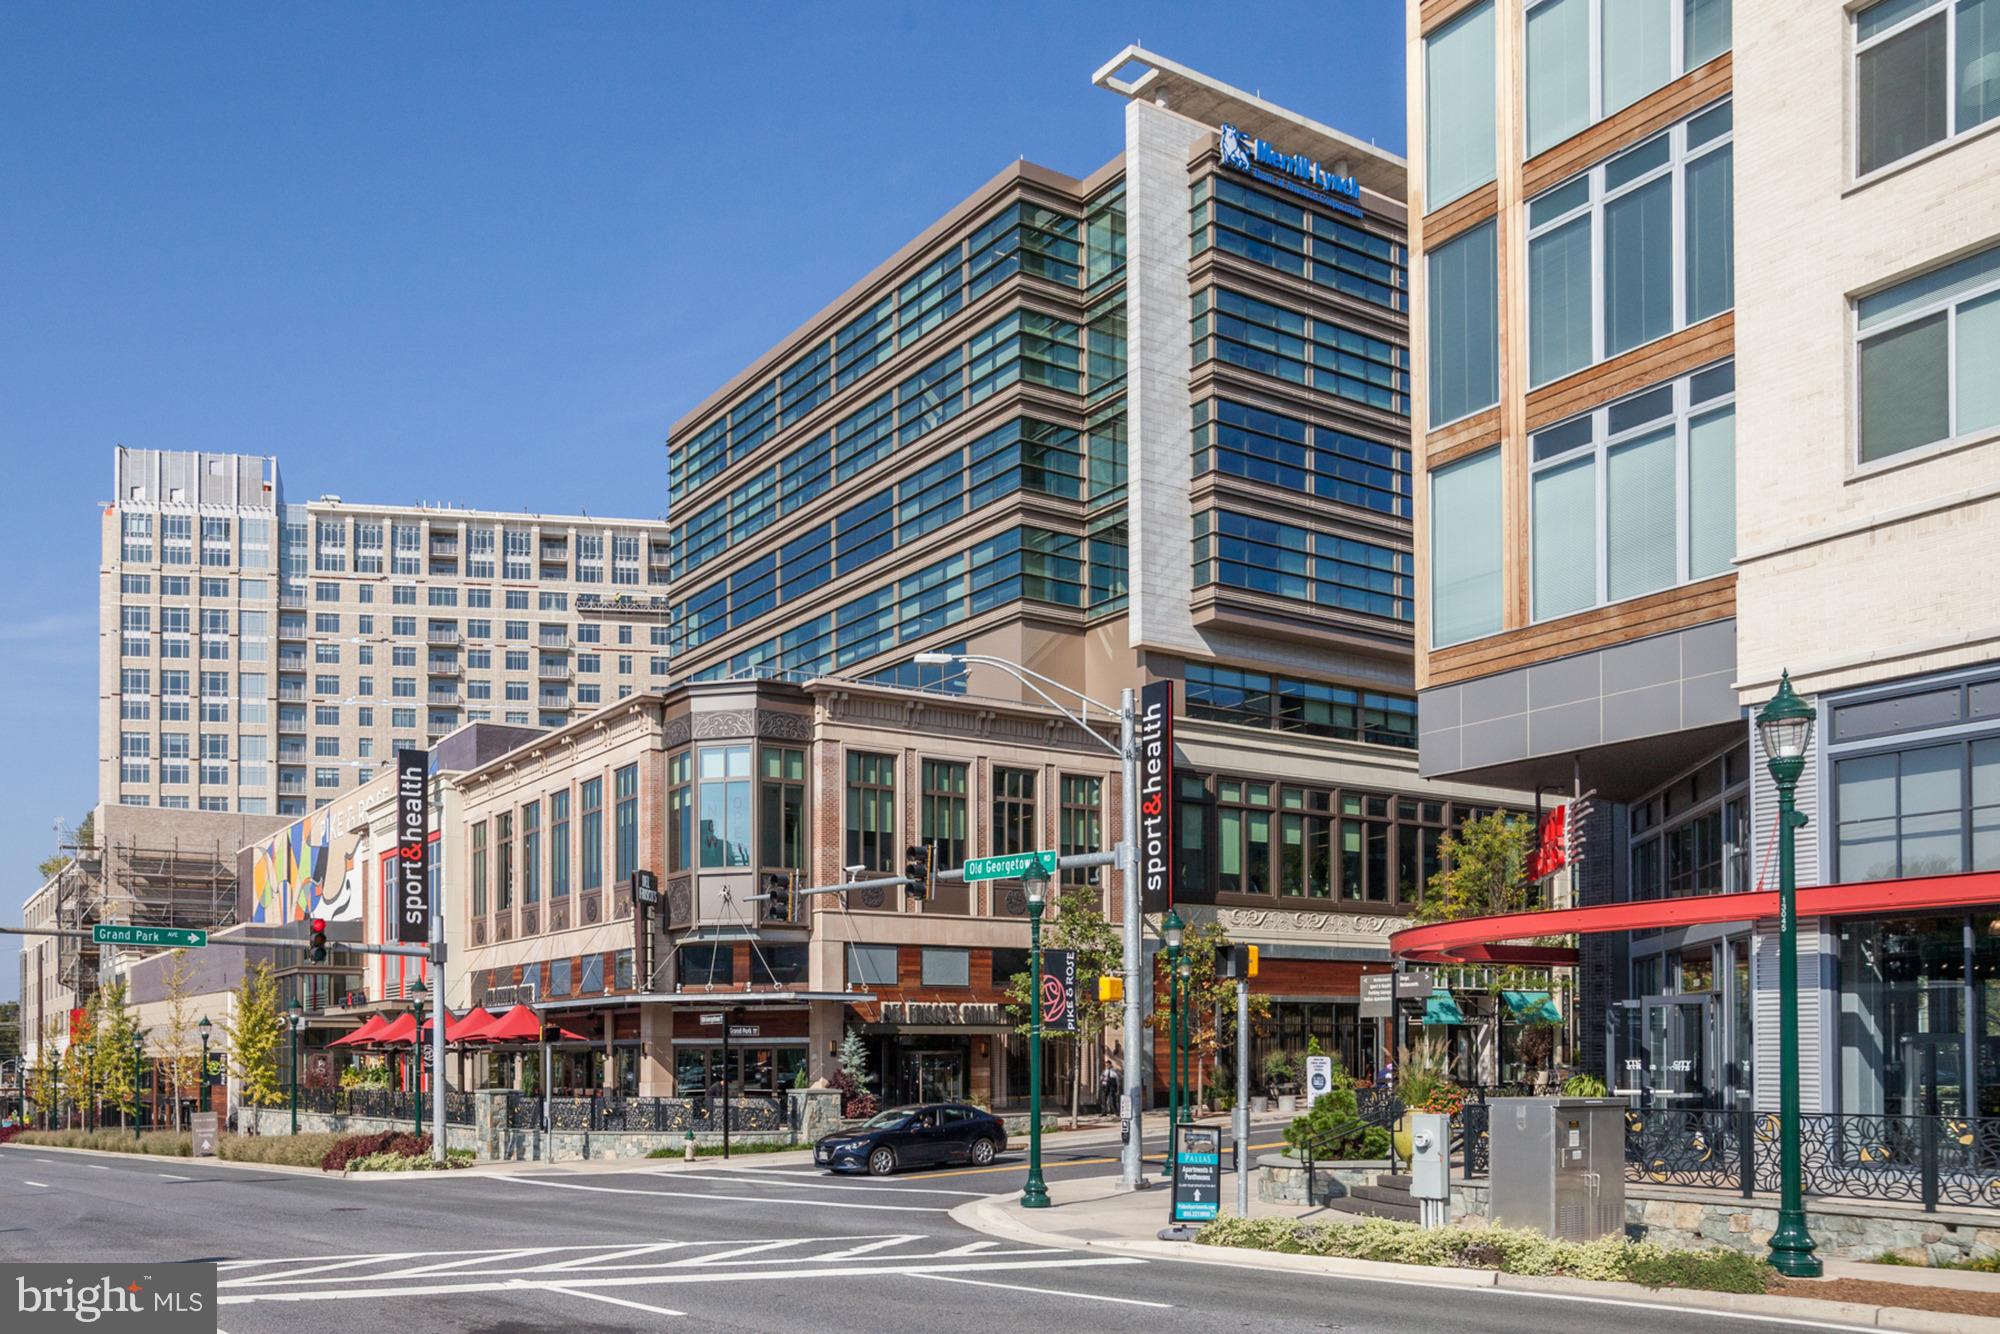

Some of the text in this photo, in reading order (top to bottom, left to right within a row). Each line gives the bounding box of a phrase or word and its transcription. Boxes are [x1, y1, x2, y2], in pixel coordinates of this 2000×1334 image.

[1254, 138, 1361, 200] Merrill Lynch
[1143, 702, 1167, 891] sport&health
[401, 767, 428, 924] sport&health
[969, 862, 982, 875] Old
[1043, 854, 1051, 862] RD
[99, 928, 131, 941] Grand
[136, 930, 159, 942] Park
[1065, 951, 1076, 1031] PIKE & ROSE
[880, 1001, 902, 1025] DEL
[1184, 1152, 1212, 1163] PALLAS
[1182, 1166, 1208, 1175] Apartments
